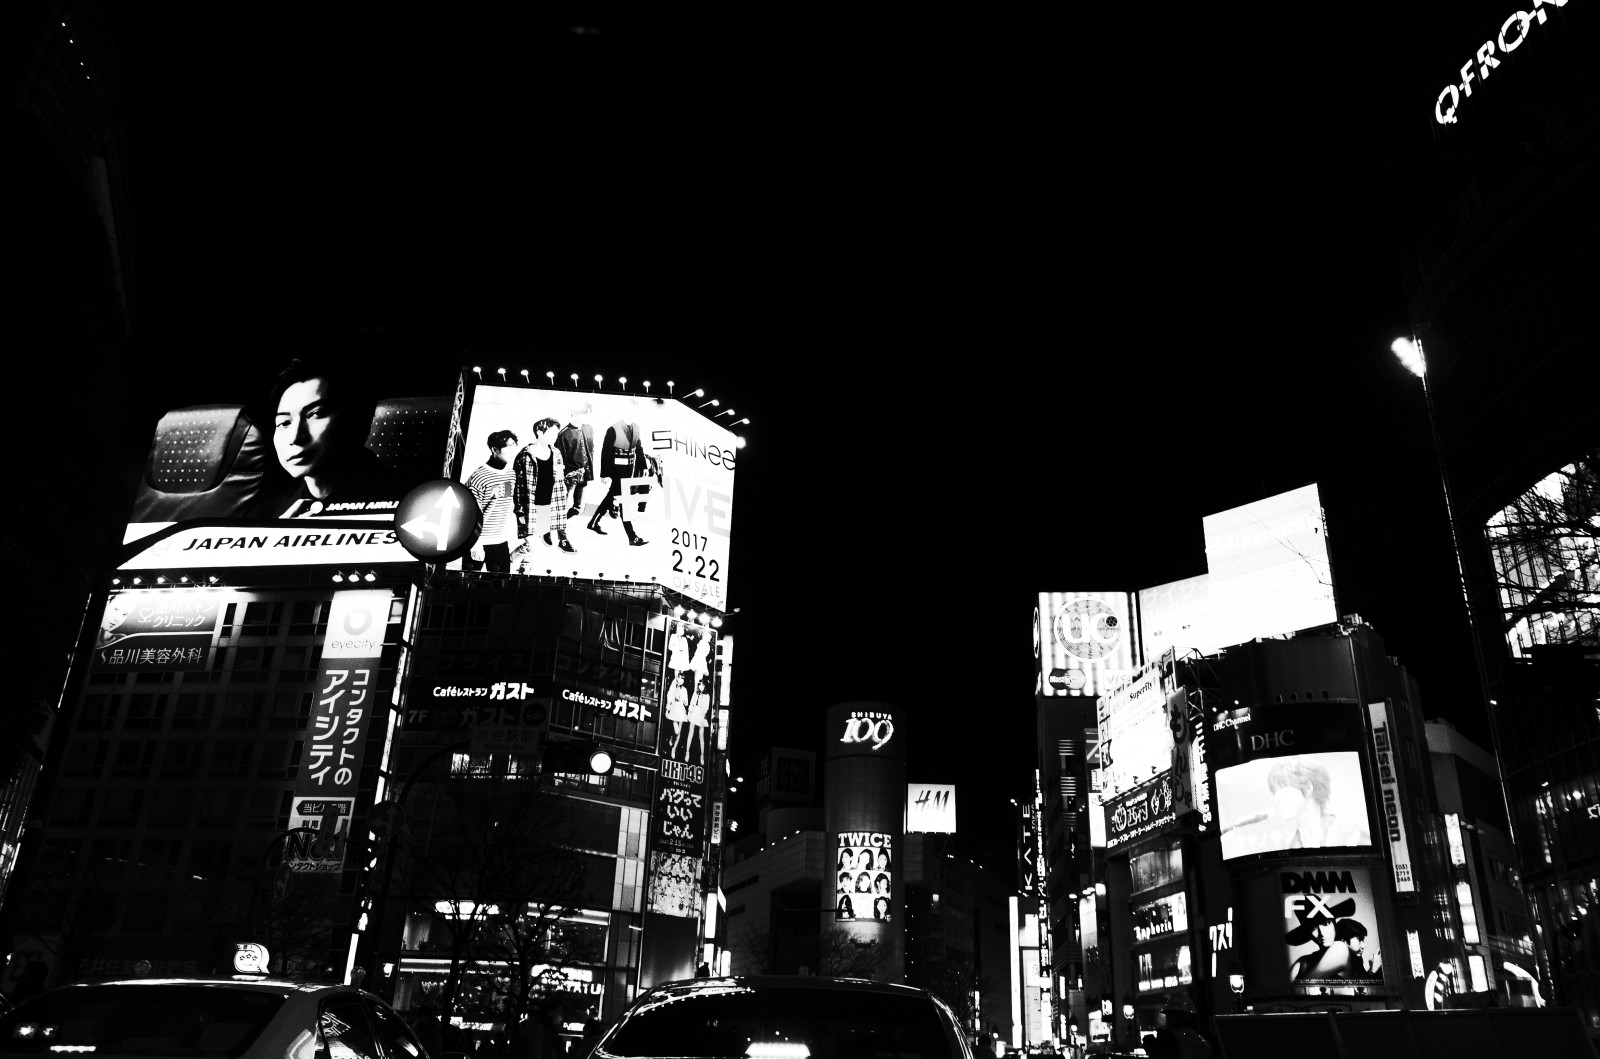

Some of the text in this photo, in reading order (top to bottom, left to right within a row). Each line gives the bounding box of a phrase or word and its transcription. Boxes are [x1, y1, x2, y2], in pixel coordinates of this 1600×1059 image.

[325, 500, 400, 512] JAPAN AIRLI
[183, 531, 400, 551] JAPAN AIRLINES
[671, 528, 708, 552] 2017
[672, 549, 720, 583] 2.22
[152, 615, 206, 628] クリニック
[331, 638, 376, 652] eyecity
[108, 647, 203, 665] 品川美容外科
[1106, 674, 1129, 686] VIS
[489, 681, 535, 701] ガスト
[612, 699, 652, 722] ガスト
[851, 711, 893, 721] SHIBUYA
[308, 669, 349, 786] アイシティ
[334, 669, 371, 786] コンタクトの
[840, 717, 894, 750] 109
[1250, 729, 1295, 751] DHC
[661, 758, 705, 785] HKT48
[1373, 721, 1401, 843] Taisei neon
[666, 804, 694, 821] いい
[663, 820, 694, 840] じゃん
[838, 832, 892, 848] TWICE
[288, 862, 342, 872] ンタクトショップ
[1280, 870, 1358, 894] DMM
[1284, 895, 1335, 919] FX
